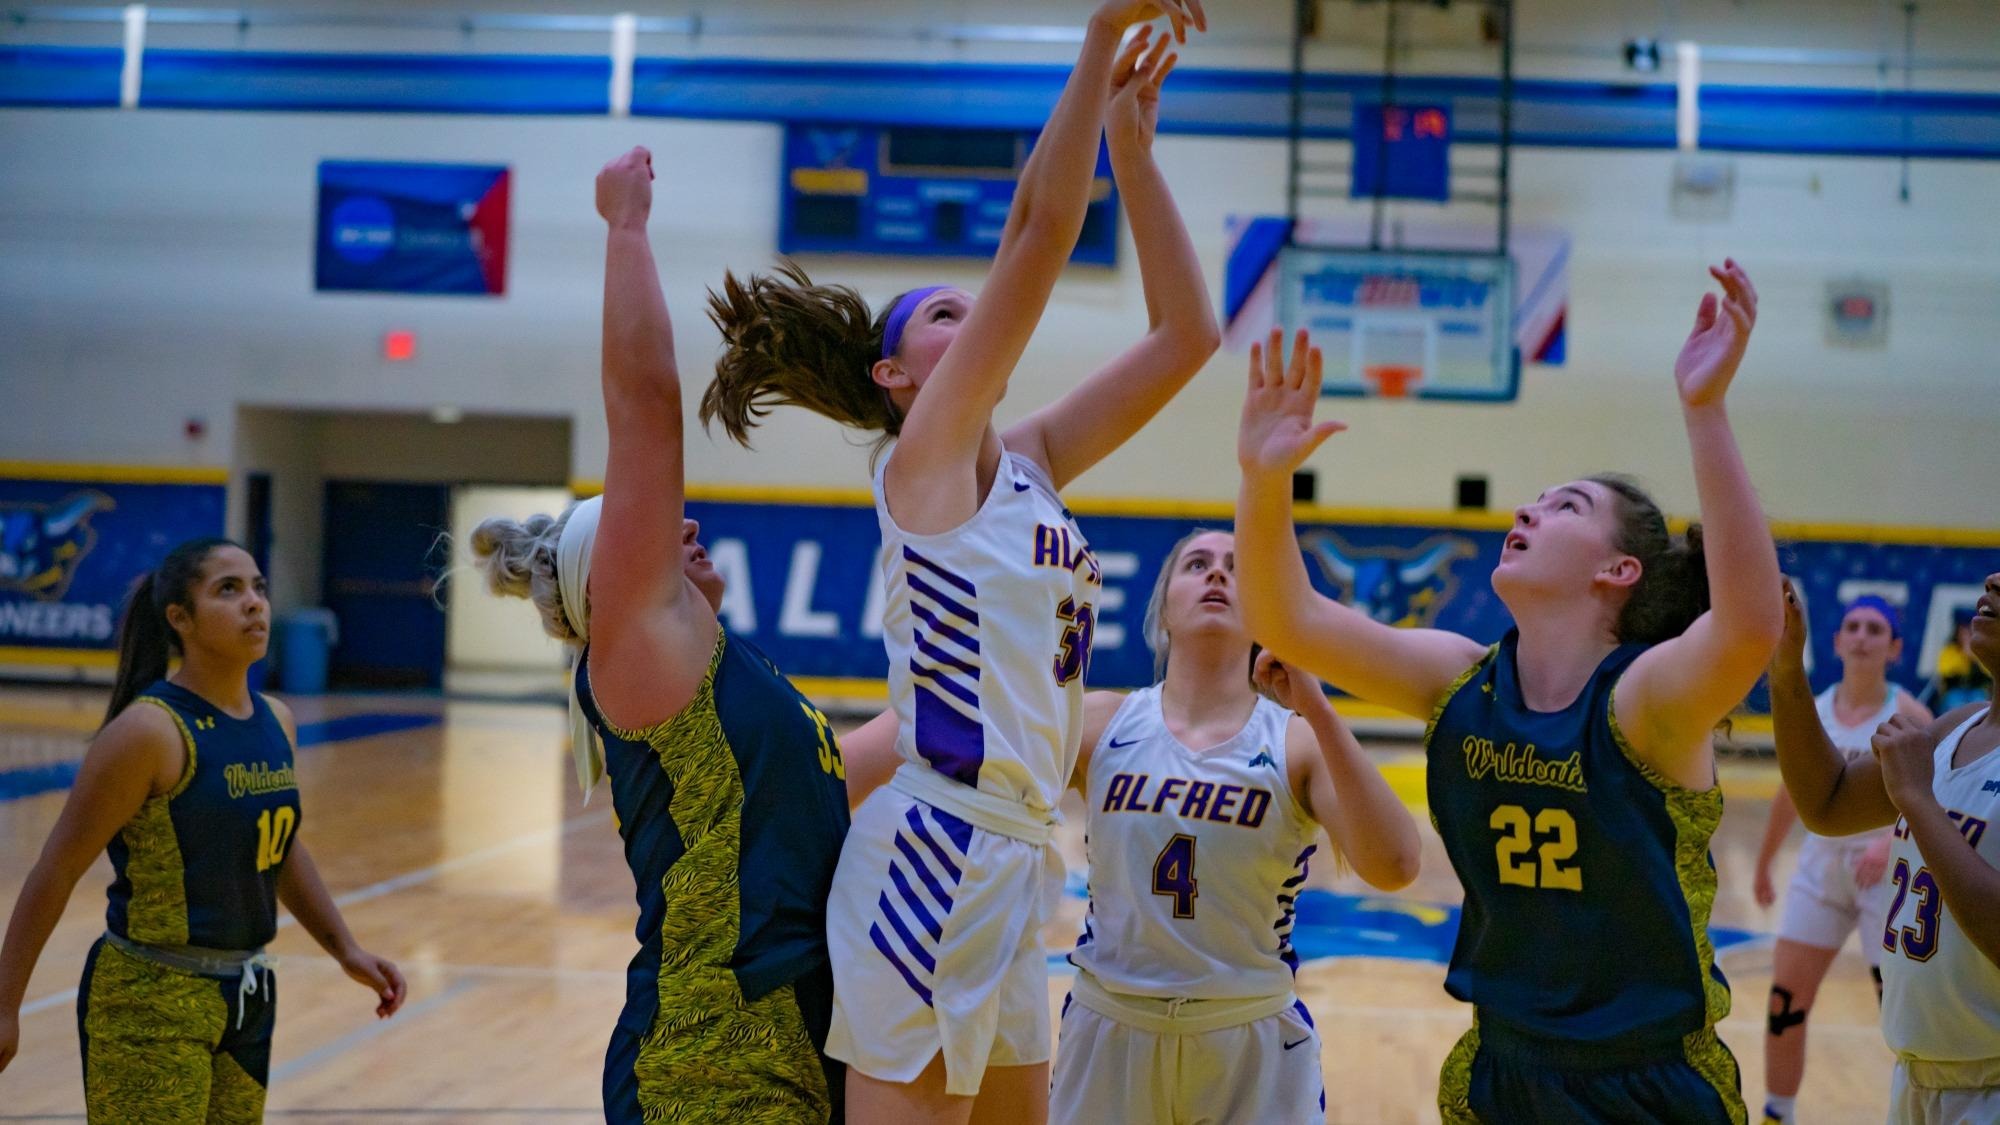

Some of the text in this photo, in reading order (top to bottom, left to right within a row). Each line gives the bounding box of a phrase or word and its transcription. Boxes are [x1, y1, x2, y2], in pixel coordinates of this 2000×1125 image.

[0, 601, 112, 640] NEERS
[224, 762, 298, 799] Wildcat
[1101, 772, 1273, 829] ALFRED
[256, 806, 296, 873] 10
[1490, 804, 1583, 892] 22
[1152, 832, 1199, 920] 4
[1883, 857, 1943, 963] 23
